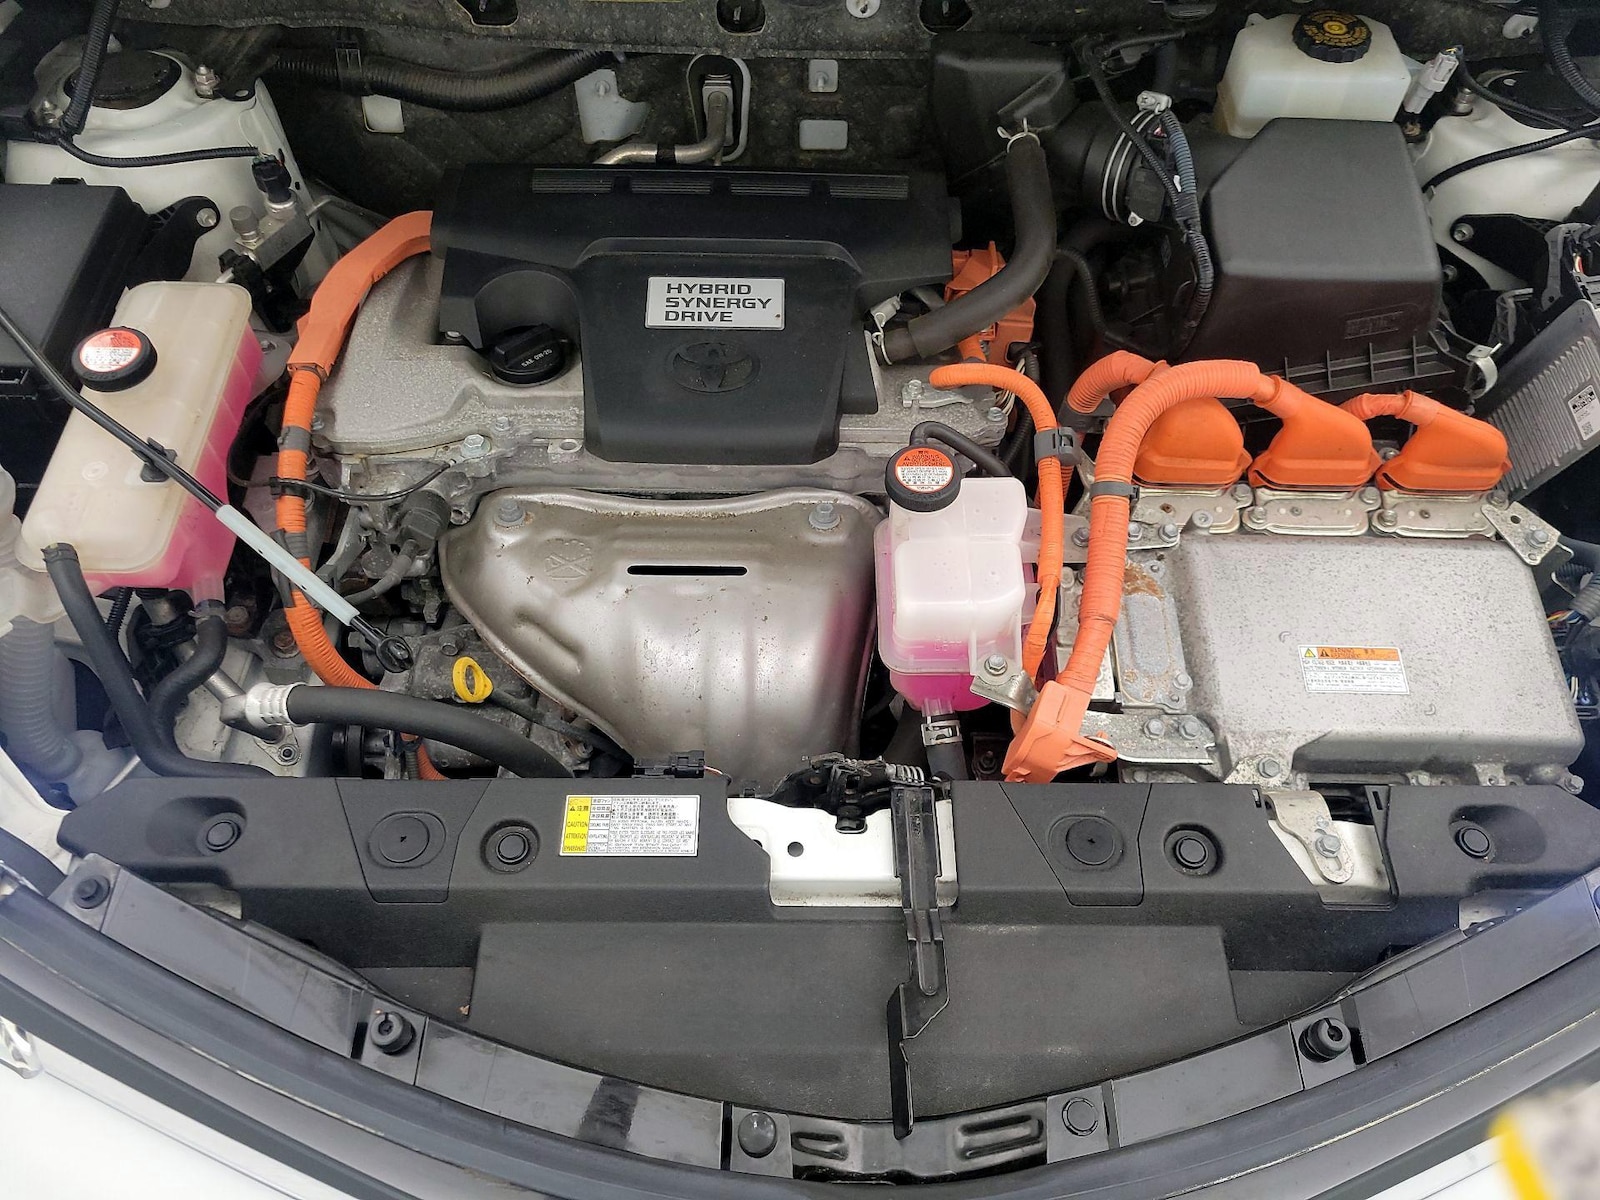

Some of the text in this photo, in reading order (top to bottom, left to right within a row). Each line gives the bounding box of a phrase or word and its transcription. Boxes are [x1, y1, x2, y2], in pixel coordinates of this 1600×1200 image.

[666, 283, 752, 295] HYBRID
[665, 297, 772, 309] SYNERGY
[664, 310, 733, 322] DRIVE
[521, 359, 534, 367] SAE
